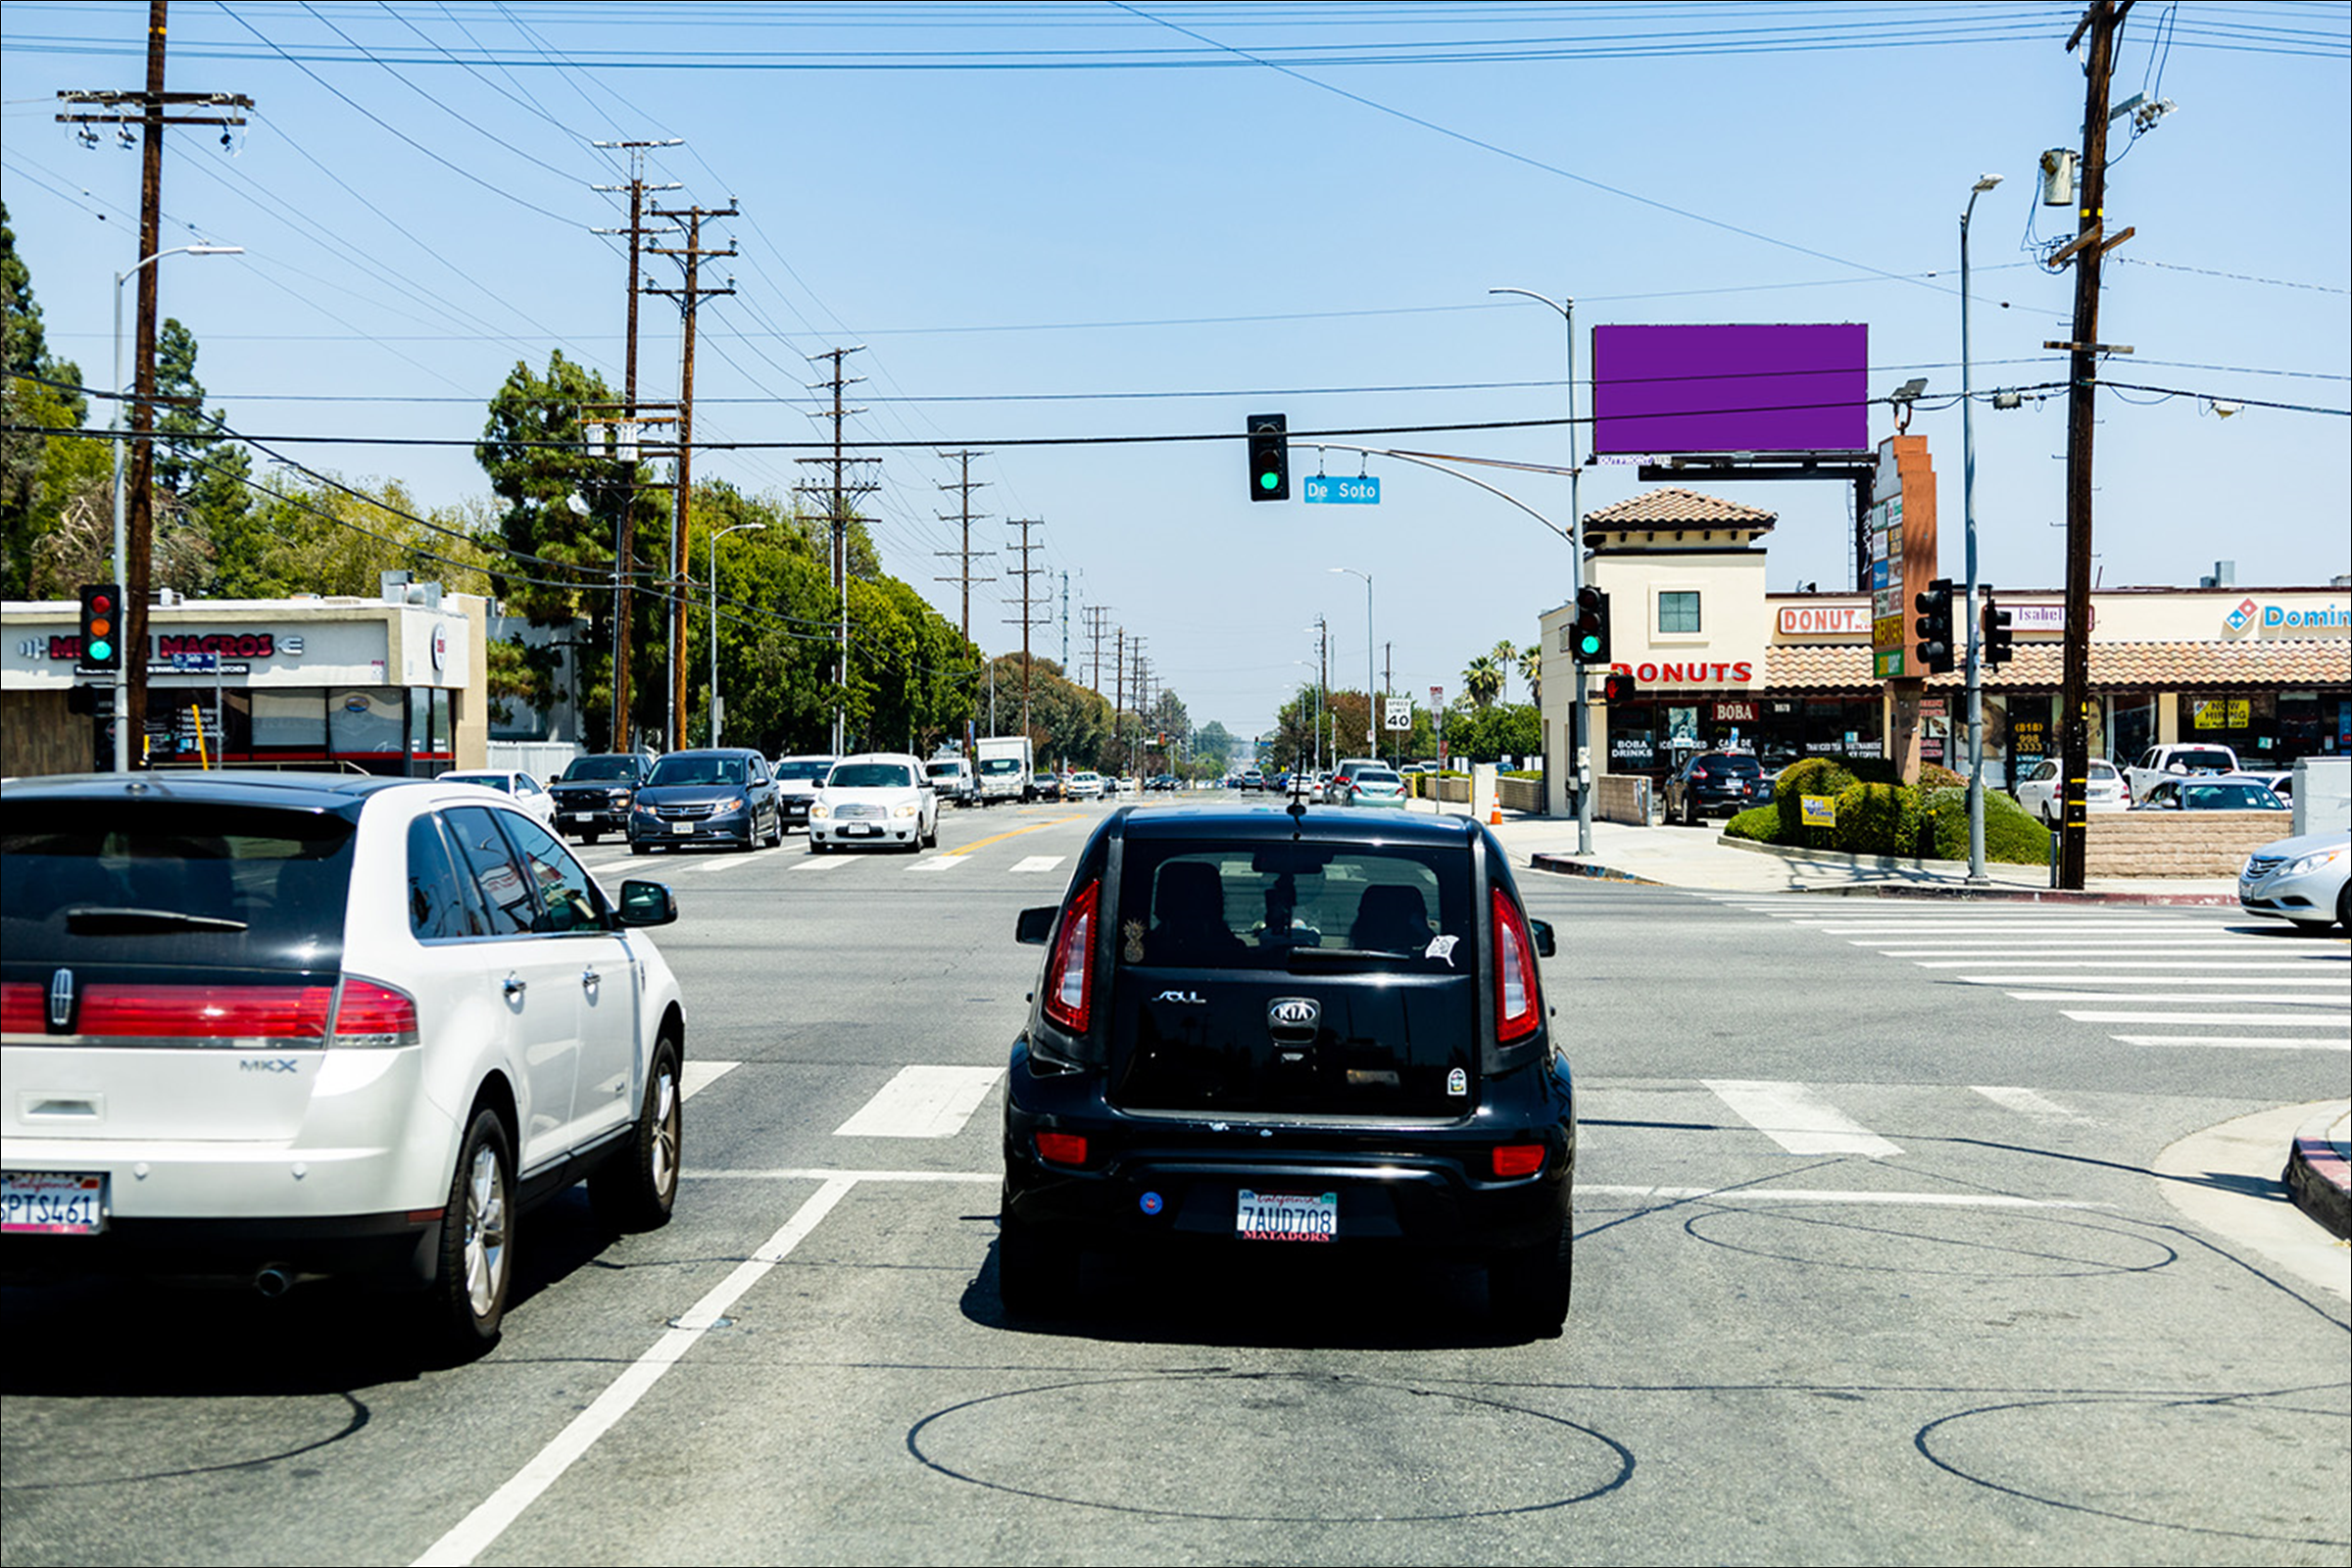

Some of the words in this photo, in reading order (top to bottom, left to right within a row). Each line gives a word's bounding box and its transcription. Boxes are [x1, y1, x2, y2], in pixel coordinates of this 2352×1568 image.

[1308, 482, 1328, 498] De
[1339, 482, 1376, 498] Soto
[1785, 610, 1855, 630] DONUT
[2019, 607, 2063, 621] Isabel
[2265, 604, 2351, 627] Domin
[160, 635, 273, 659] MACROS
[1610, 662, 1752, 683] DONUTS
[1717, 705, 1753, 720] BOBA
[2205, 710, 2246, 719] HIRNG
[1388, 715, 1409, 727] 40
[2015, 722, 2043, 732] (818)
[1617, 740, 1648, 749] BOBA
[2016, 743, 2042, 752] 3333
[1611, 749, 1653, 758] DRINKS
[1152, 991, 1206, 1003] SOUL
[1278, 1006, 1309, 1020] KIA
[240, 1059, 298, 1072] MKX
[11, 1176, 81, 1193] California
[1257, 1195, 1319, 1207] California
[1243, 1206, 1332, 1234] 7AUD708
[1243, 1231, 1330, 1243] MATADORS
